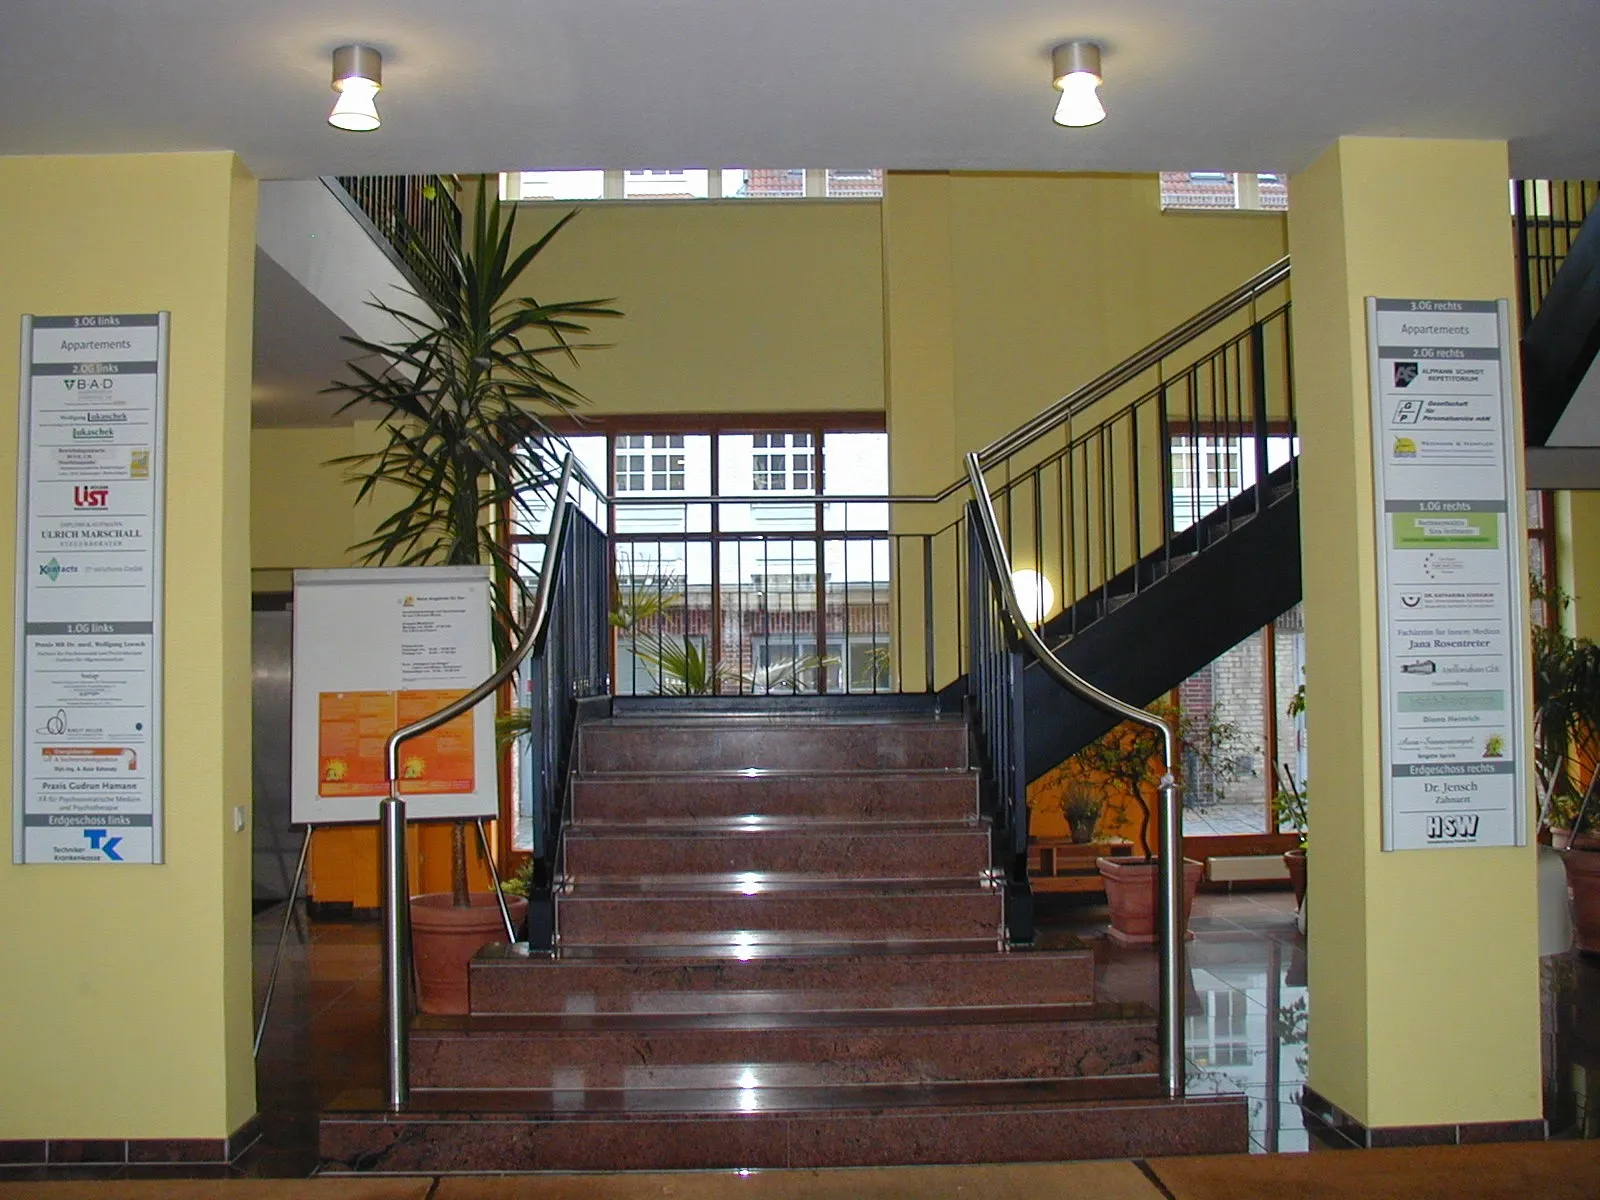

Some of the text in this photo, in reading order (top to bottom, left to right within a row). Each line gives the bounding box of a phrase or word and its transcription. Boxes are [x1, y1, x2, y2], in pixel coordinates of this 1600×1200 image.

[1410, 301, 1462, 311] 3.OG rechts
[74, 316, 120, 327] 3.OG links
[1401, 324, 1469, 335] Appartements
[61, 340, 131, 351] Appartements
[1413, 348, 1465, 358] 2.OG rechts
[72, 364, 119, 374] 2.OG links
[1420, 502, 1471, 511] 1.OG rechts
[41, 529, 141, 539] ULRICH MARSCHALL
[67, 623, 114, 633] 1.OG links
[1408, 640, 1491, 650] Jana Rosentreter
[1410, 763, 1495, 776] Erdgeschoss rechts
[42, 782, 137, 790] Praxis Gudrun Hamann
[1424, 782, 1440, 793] Dr.
[1435, 796, 1470, 804] Zahnarzt
[49, 815, 131, 827] Erdgeschoss links
[1427, 814, 1479, 838] HSW
[83, 829, 124, 861] TK
